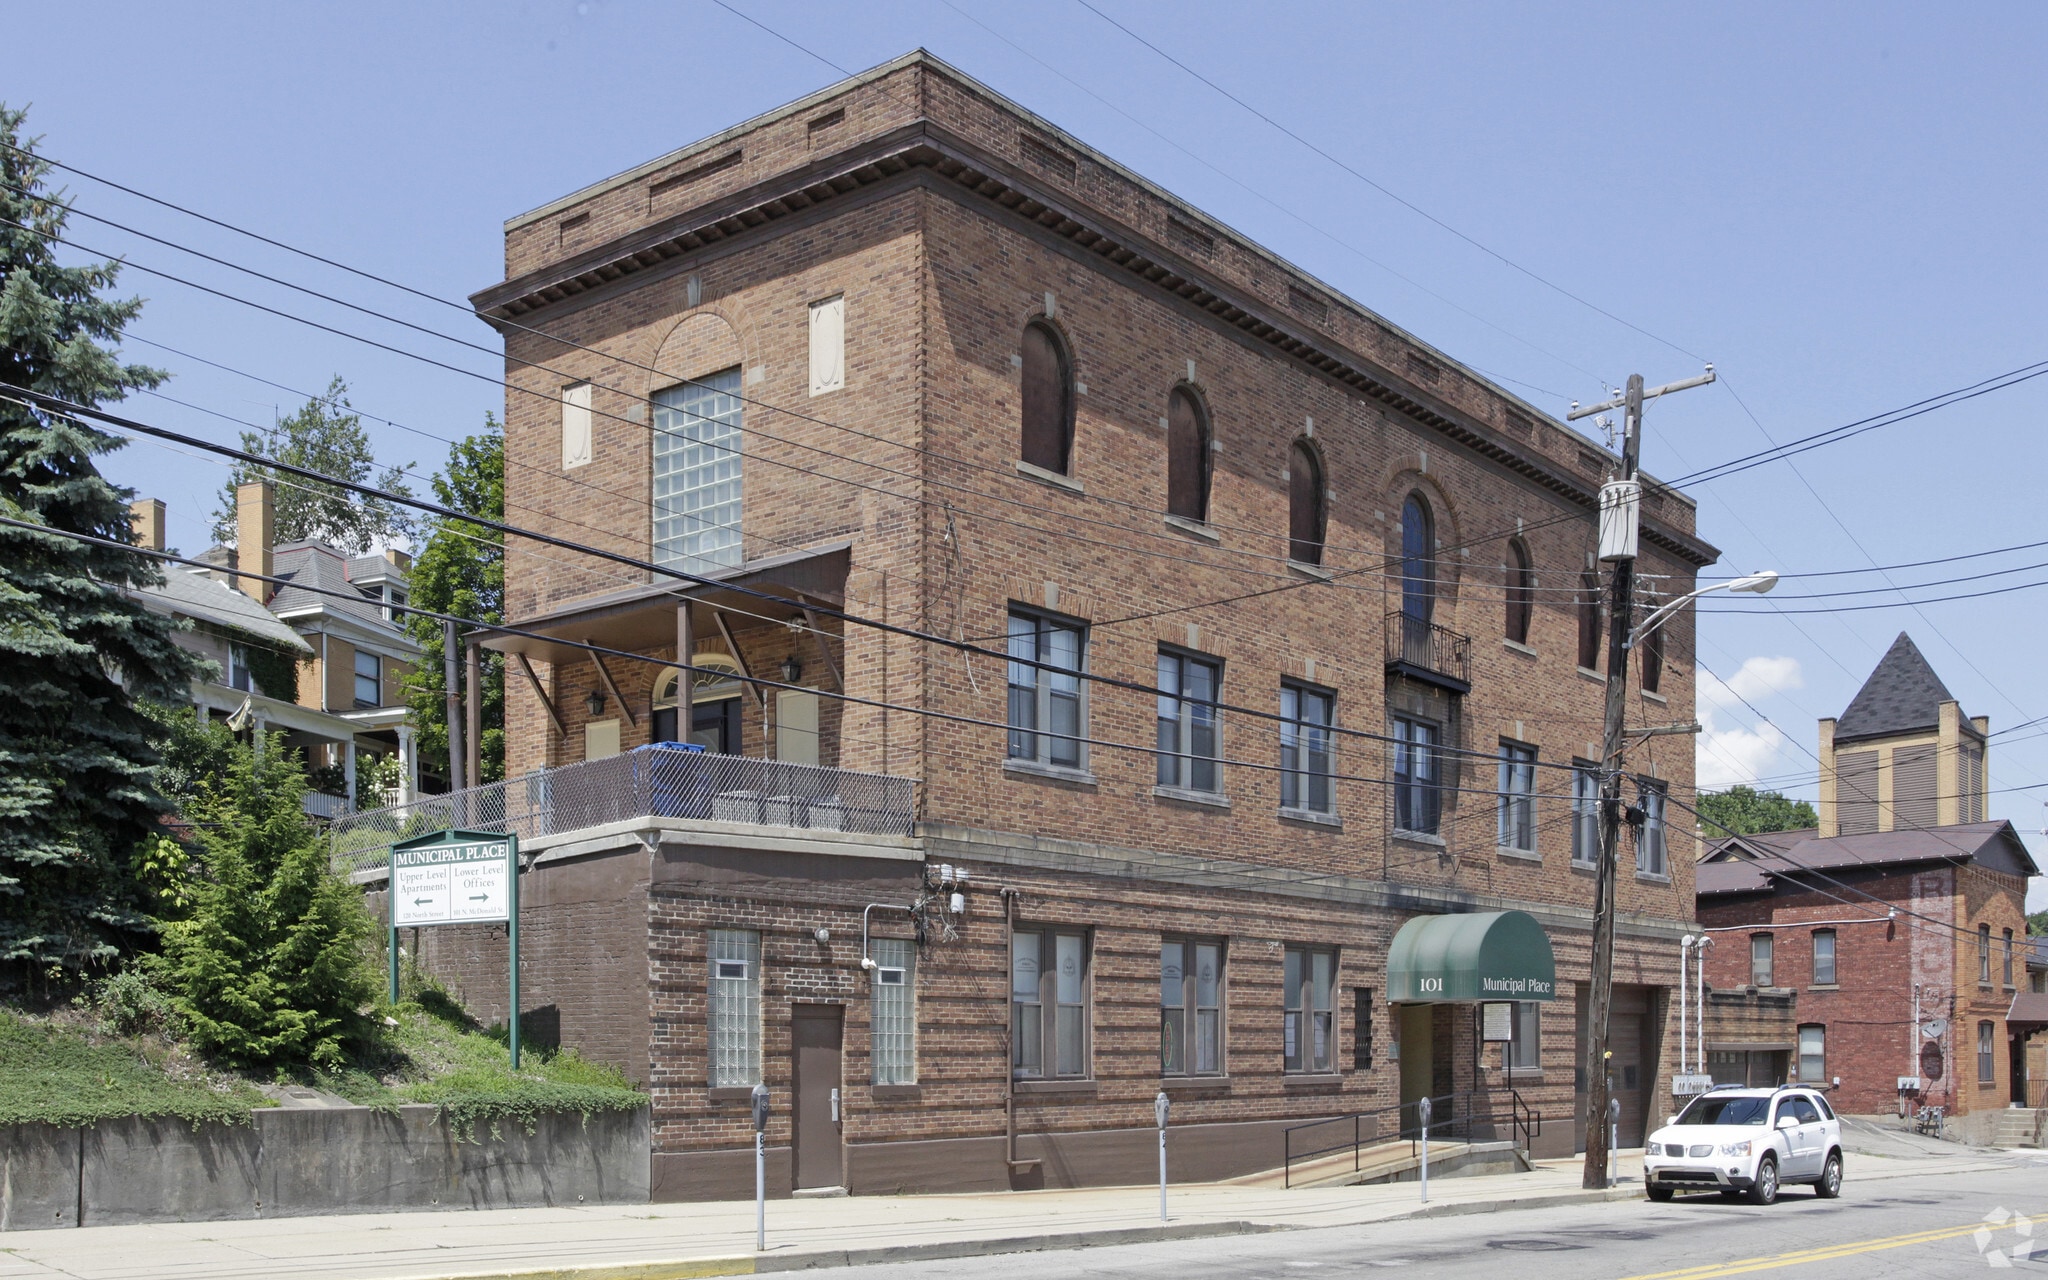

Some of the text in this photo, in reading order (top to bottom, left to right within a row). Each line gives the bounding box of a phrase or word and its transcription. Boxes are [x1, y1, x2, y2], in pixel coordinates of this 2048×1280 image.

[397, 844, 506, 866] MUNICIPAL PLACE
[399, 868, 447, 884] Upper Level
[454, 863, 504, 877] Lower Level
[400, 882, 447, 896] Apartments
[463, 877, 495, 889] Offices
[412, 910, 428, 919] North
[428, 910, 444, 918] Street
[468, 906, 496, 915] McDonald
[1419, 977, 1443, 992] 101
[1482, 976, 1551, 995] Municipal Place
